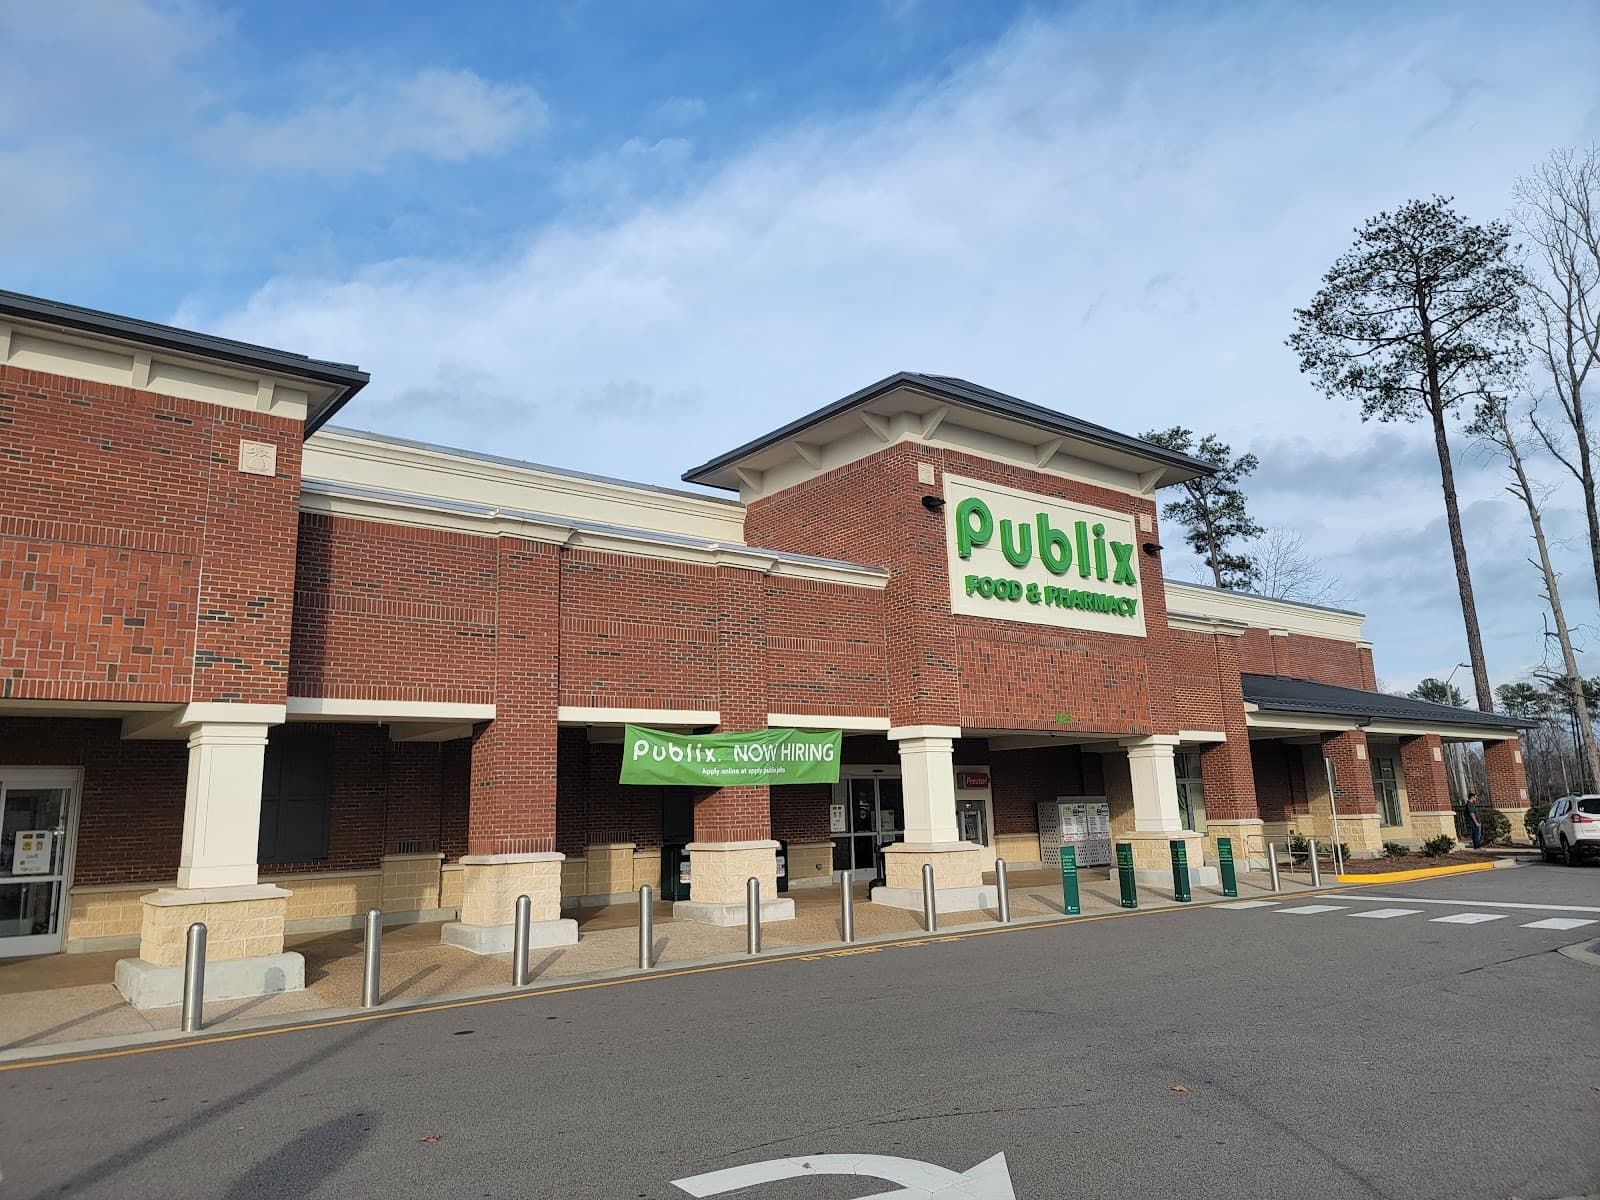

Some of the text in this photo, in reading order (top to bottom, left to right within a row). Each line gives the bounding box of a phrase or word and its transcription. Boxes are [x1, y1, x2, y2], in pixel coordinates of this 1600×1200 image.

[956, 497, 1137, 585] Publix
[965, 575, 1138, 617] FOOD & PHARMACY
[733, 743, 778, 762] NOW
[781, 743, 834, 762] HIRING
[702, 767, 719, 776] Apply
[720, 767, 739, 775] online
